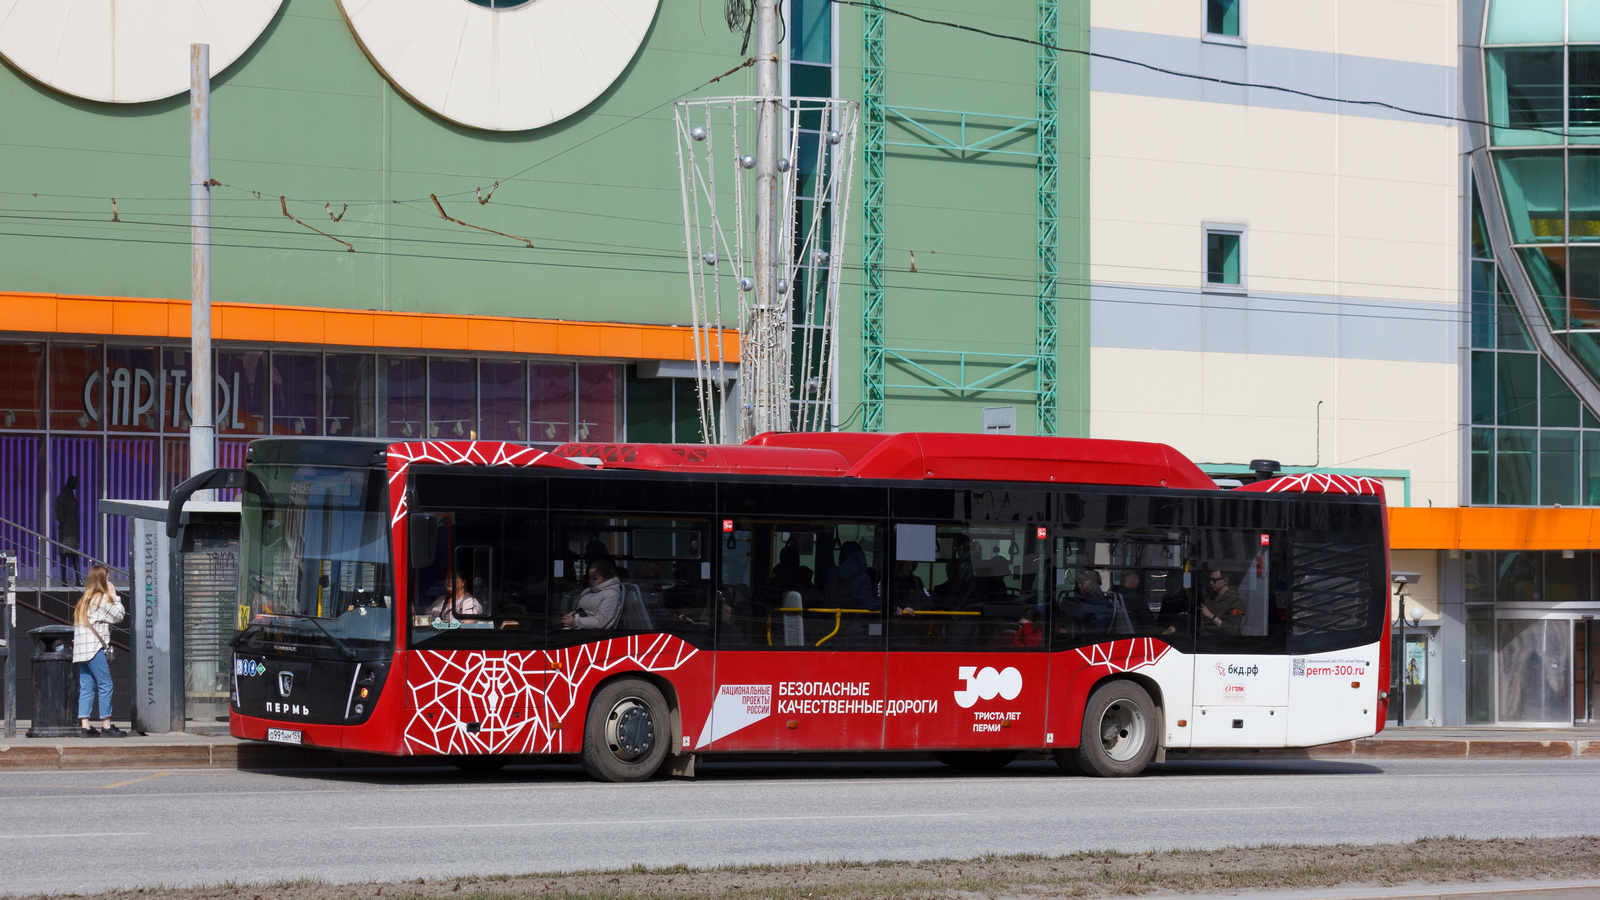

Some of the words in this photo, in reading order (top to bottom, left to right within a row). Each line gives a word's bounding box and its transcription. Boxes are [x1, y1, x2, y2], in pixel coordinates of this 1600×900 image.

[145, 533, 154, 650] РЕВОЛЮЦИИ
[1227, 662, 1259, 677] бкд.рф
[1306, 665, 1365, 678] perm-300.ru
[147, 655, 156, 706] улица
[954, 666, 1023, 708] 300
[721, 685, 771, 697] НАЦИОНАЛЬНЫЕ
[778, 681, 870, 696] БЕЗОПАСНЫЕ
[741, 696, 770, 705] ПРОЕКТЫ
[777, 700, 884, 714] КАЧЕСТВЕННЫЕ
[885, 699, 938, 716] ДОРОГИ
[266, 701, 310, 716] ПЕРМЬ
[746, 705, 770, 715] РОССИИ
[974, 711, 1005, 720] ТРИСТА
[1005, 711, 1022, 720] ЛЕТ
[972, 723, 1001, 732] ПЕРМИ
